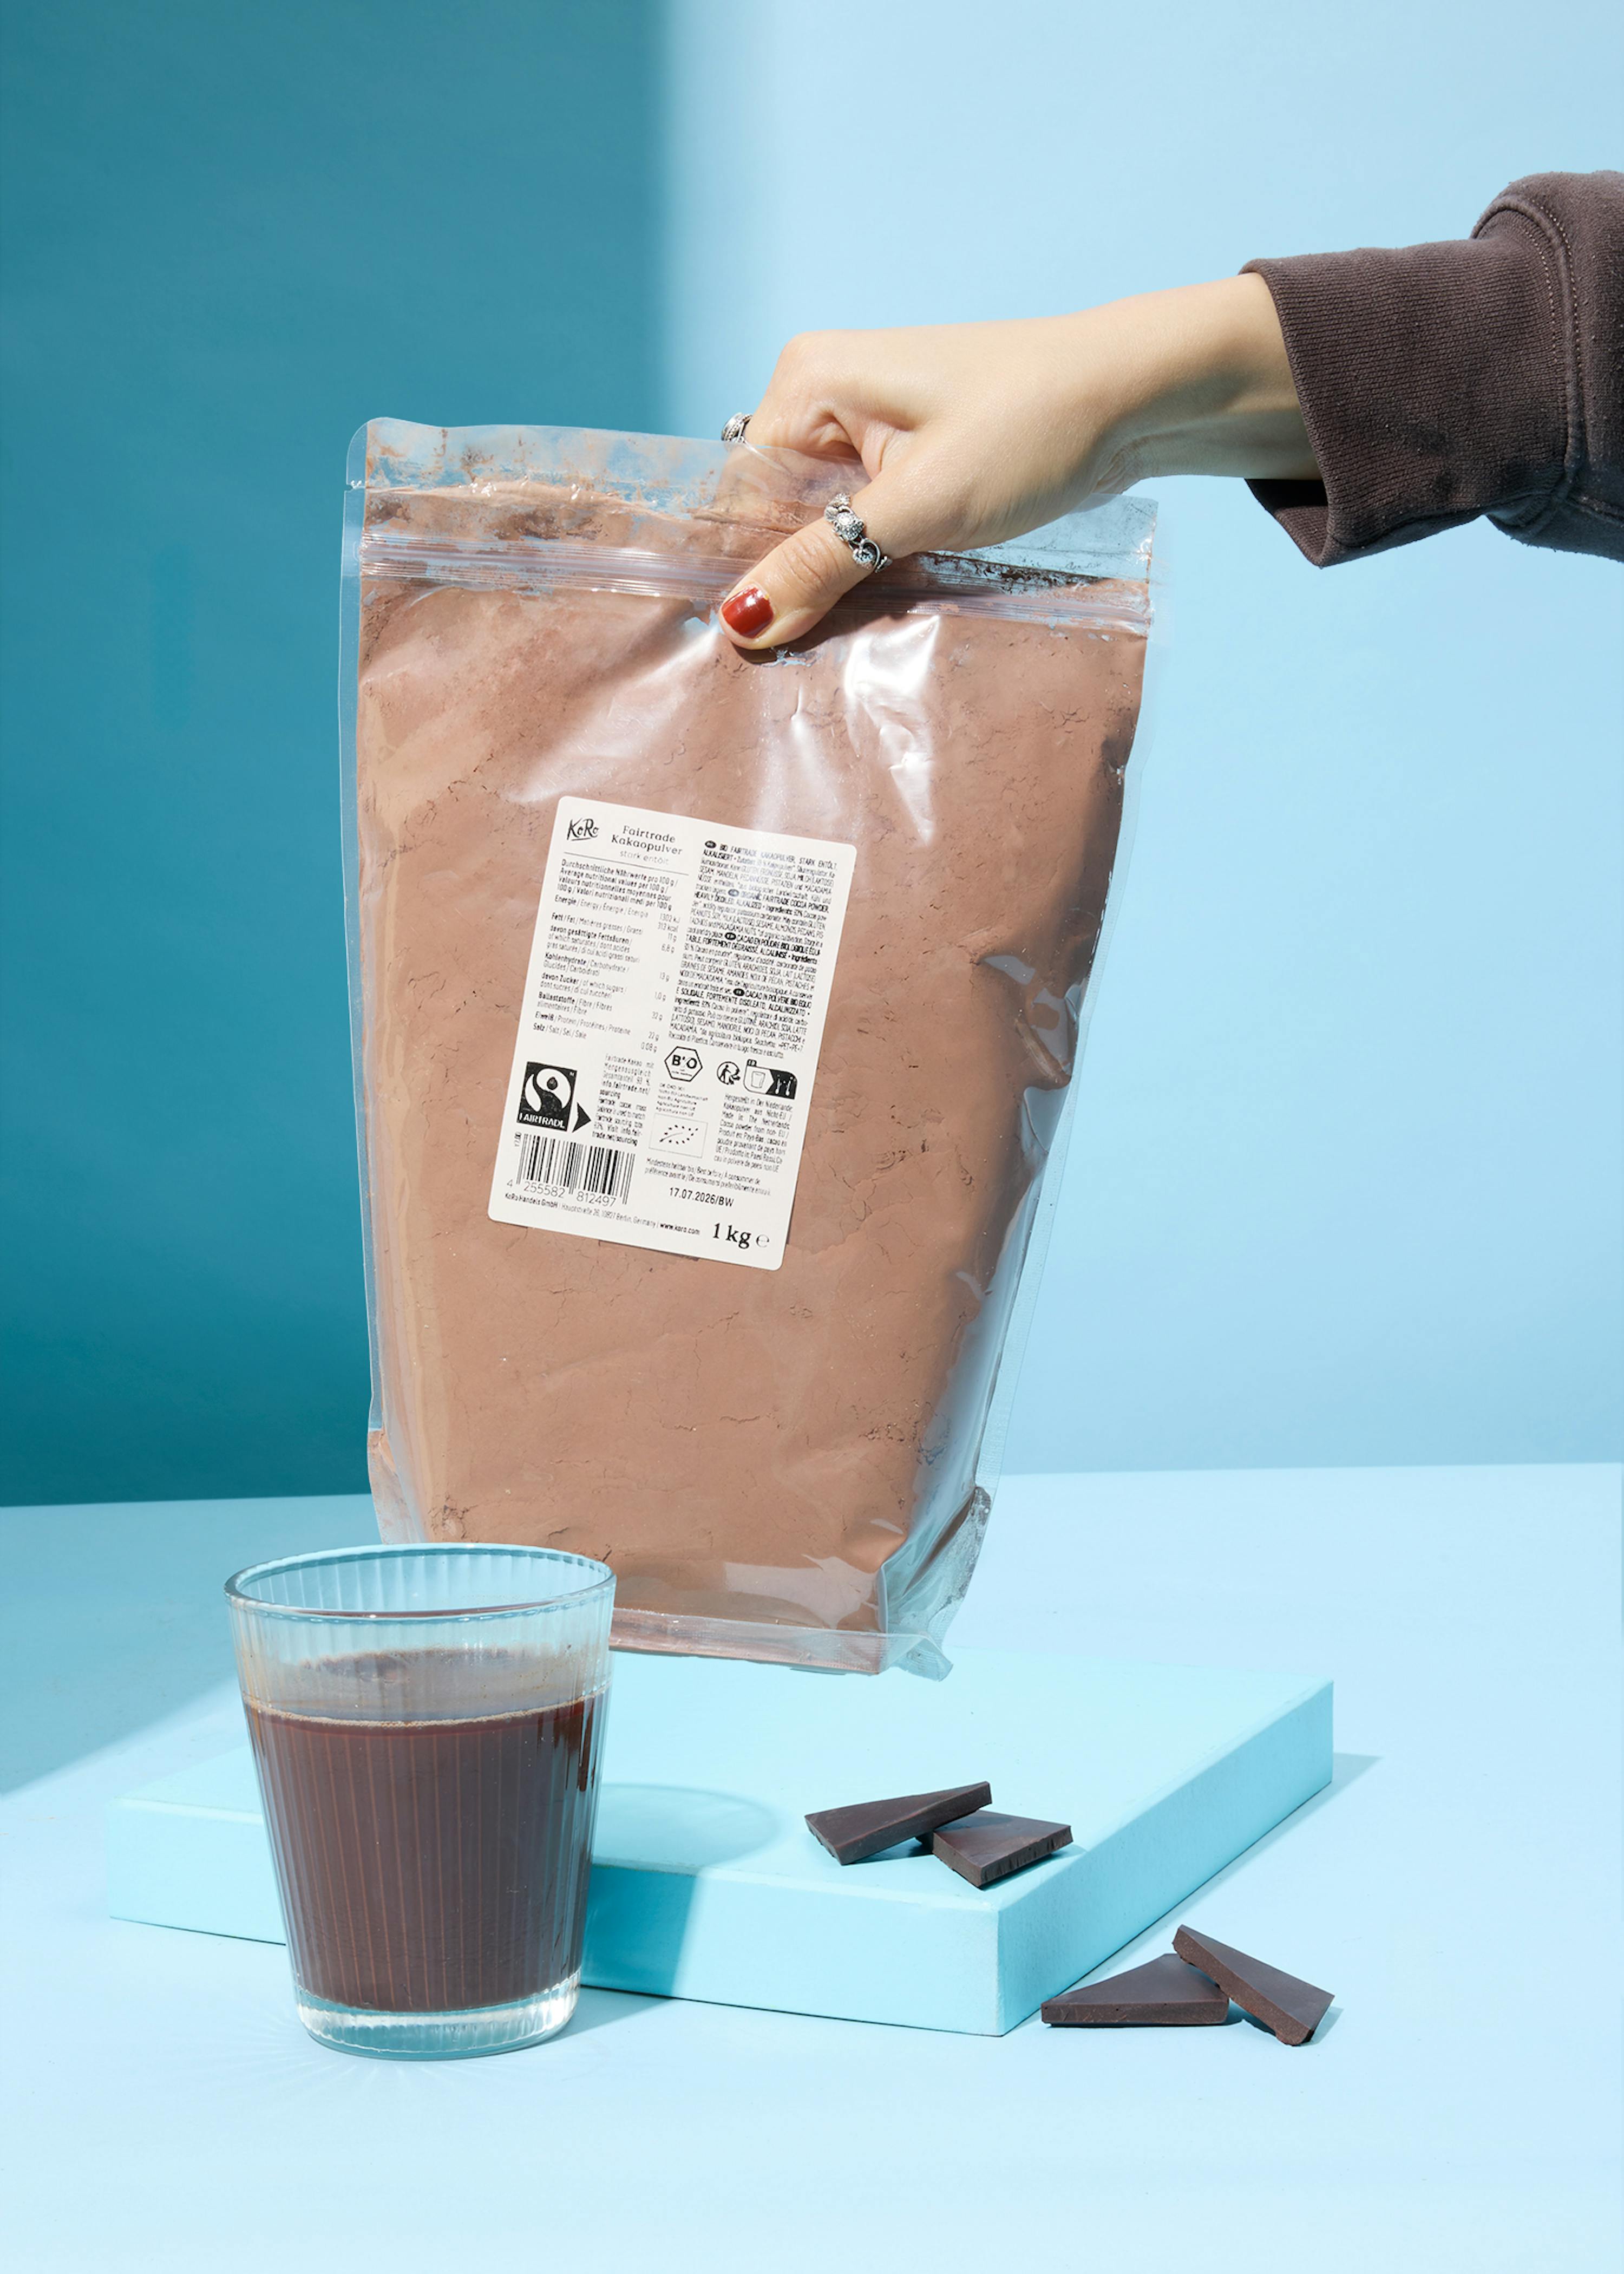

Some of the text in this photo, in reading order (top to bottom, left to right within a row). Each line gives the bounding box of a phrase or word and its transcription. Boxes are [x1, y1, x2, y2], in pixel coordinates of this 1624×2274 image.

[566, 818, 599, 841] KoRo
[622, 825, 675, 842] Fairtrade
[611, 834, 682, 854] Kakaopulver
[619, 850, 669, 865] stark entölt
[560, 867, 584, 878] Average
[585, 872, 617, 884] nutritional
[618, 879, 637, 887] values
[649, 883, 659, 891] 100
[561, 858, 614, 875] Durchschnittliche
[615, 868, 646, 880] Nährwerte
[659, 875, 670, 885] 100
[557, 883, 567, 891] 100
[577, 886, 594, 896] Valori
[657, 901, 667, 909] 100
[559, 875, 671, 903] Valeurs nutritionnelles moyennes pour
[554, 894, 577, 905] Energie
[580, 899, 599, 910] Energy
[551, 912, 563, 921] Fett
[566, 915, 575, 923] Fat
[549, 925, 629, 944] davon gesättigte Fettsäuren
[666, 924, 678, 932] kcal
[545, 951, 586, 965] Kohlenhydrate
[541, 972, 558, 981] davon
[559, 975, 579, 984] Zucker
[538, 991, 575, 1004] Ballaststoffe
[533, 1023, 545, 1031] Salz
[519, 1113, 564, 1128] FAIRTRADE
[506, 1179, 616, 1207] 4 255582 812497
[518, 1195, 540, 1205] Handels
[541, 1199, 558, 1208] GmbH
[670, 1187, 734, 1207] 17.07.2026/BW
[712, 1223, 720, 1239] 1
[725, 1224, 751, 1249] kg
